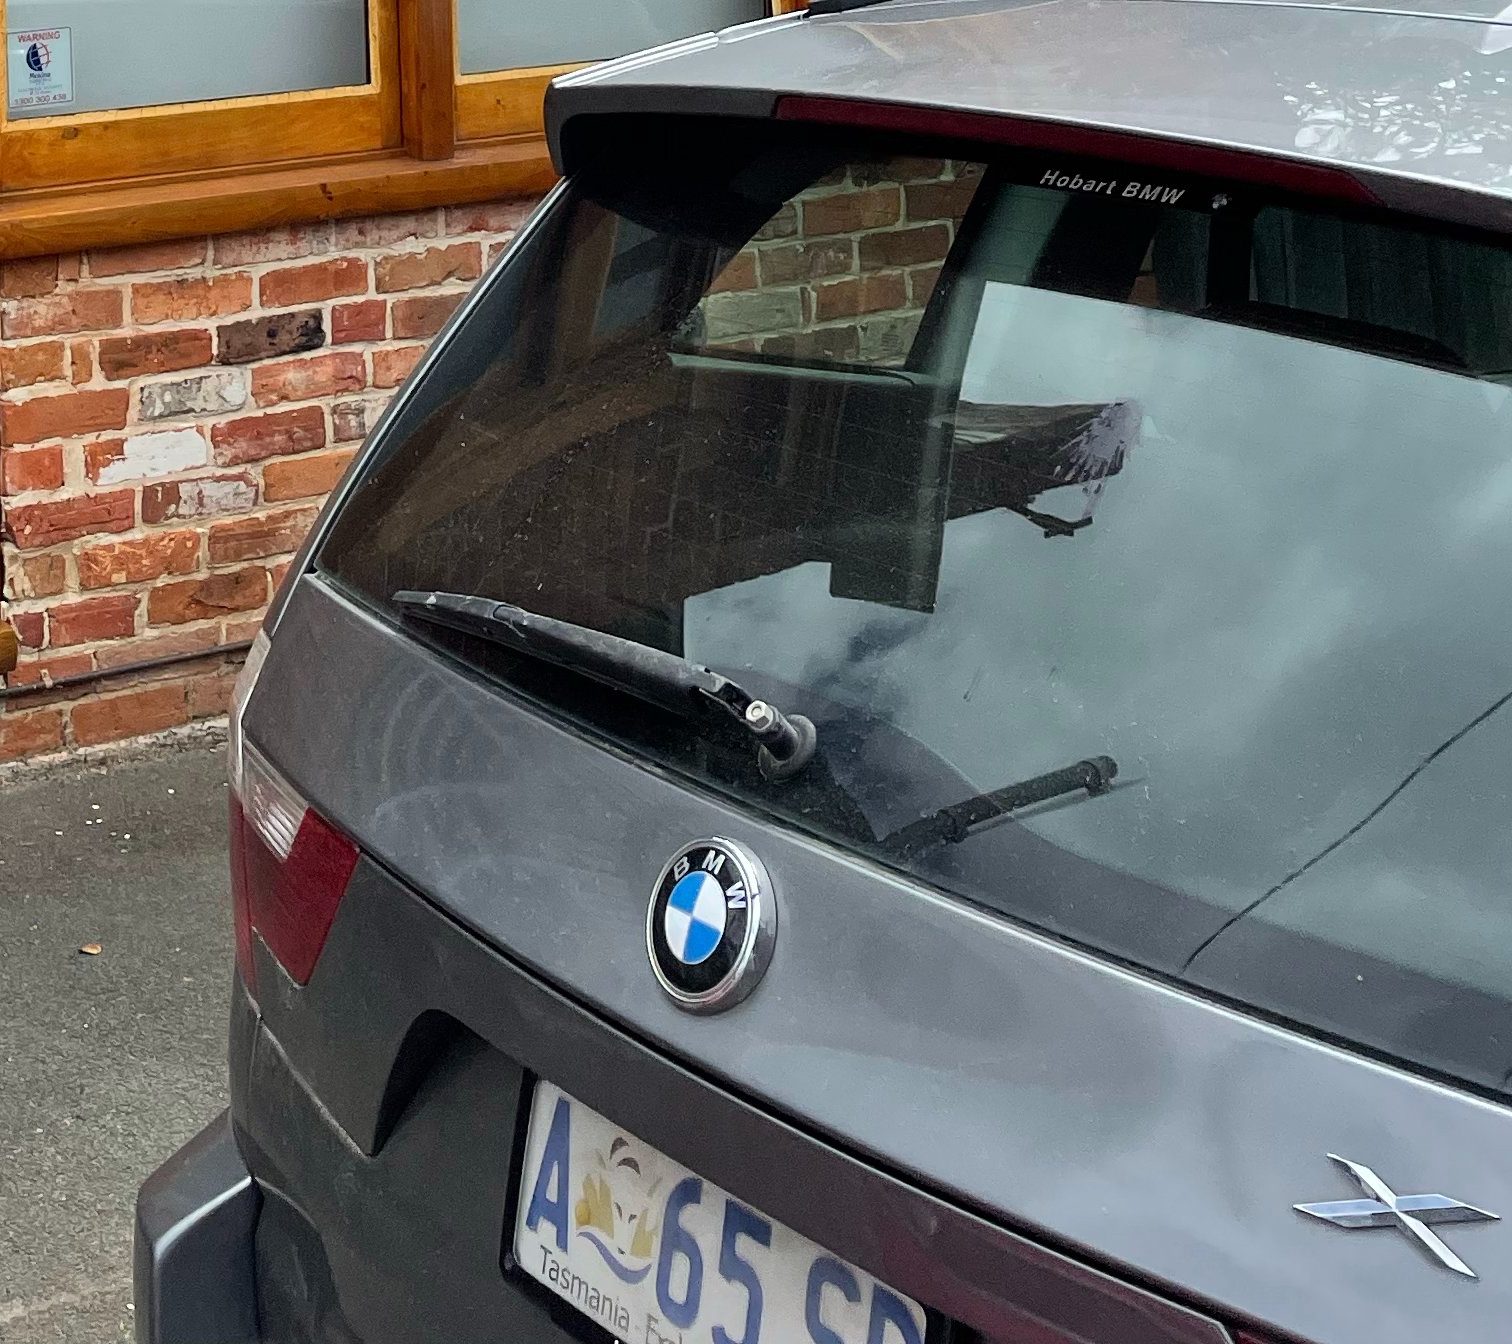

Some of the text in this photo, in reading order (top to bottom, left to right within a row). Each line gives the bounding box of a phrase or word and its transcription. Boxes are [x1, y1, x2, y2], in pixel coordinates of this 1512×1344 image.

[17, 31, 61, 43] WARNING
[1039, 169, 1186, 205] Hobart BMW
[673, 849, 747, 909] BMW
[539, 1244, 630, 1334] Tasmania
